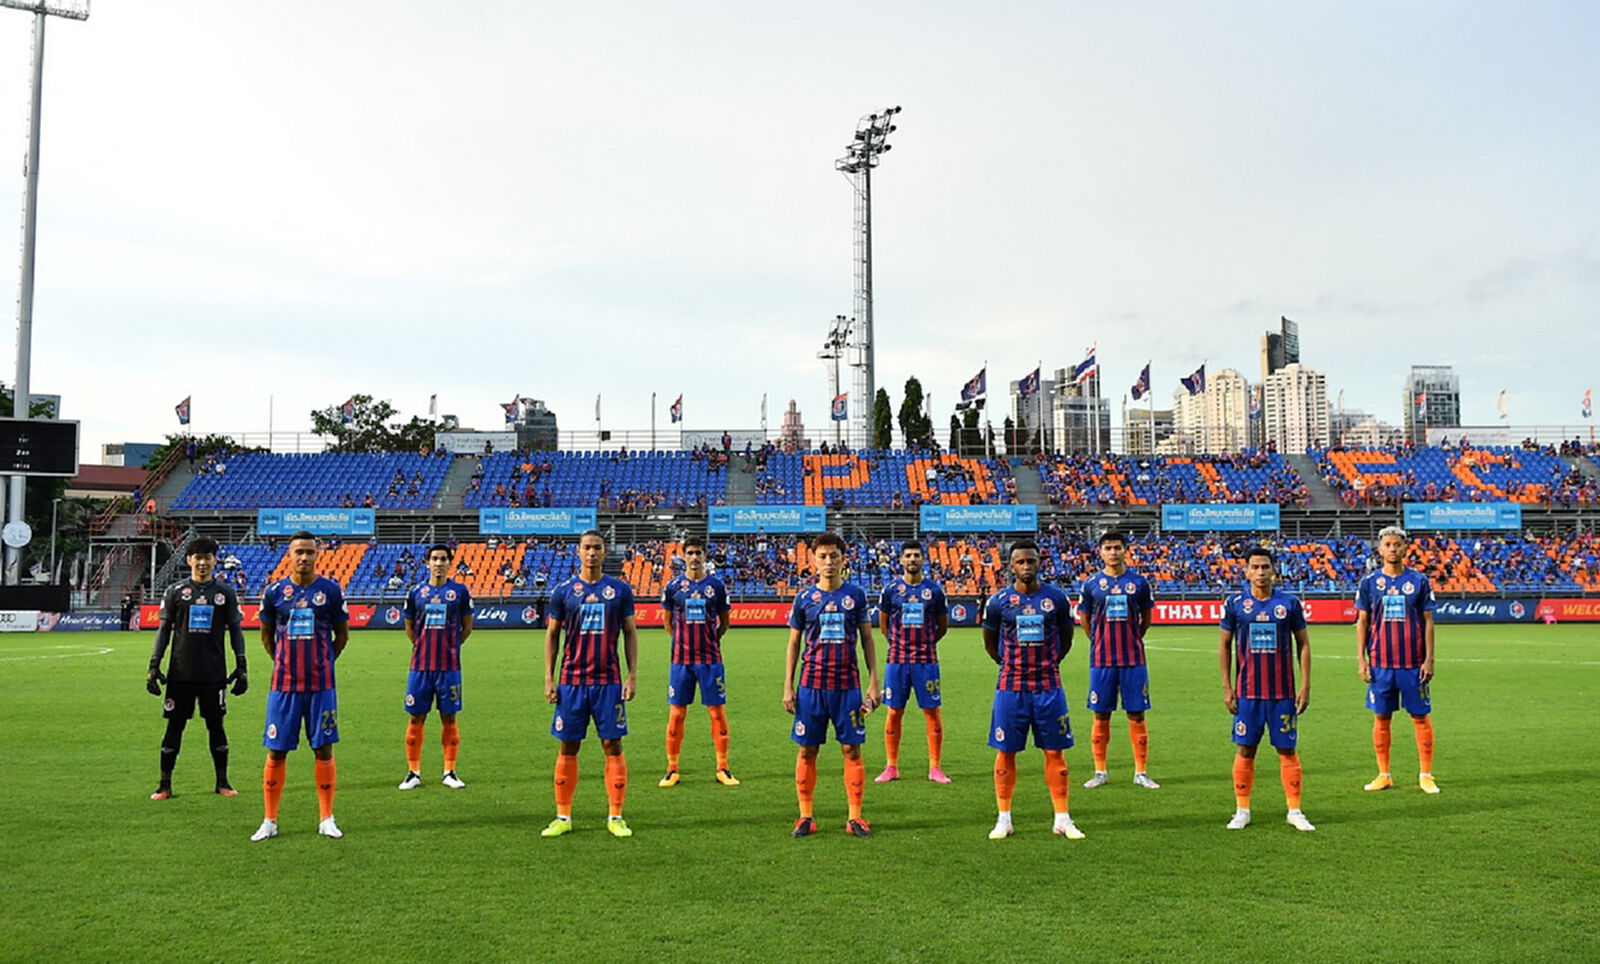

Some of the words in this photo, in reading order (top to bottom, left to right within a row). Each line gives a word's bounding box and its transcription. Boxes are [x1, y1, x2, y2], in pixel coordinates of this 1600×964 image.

[477, 607, 508, 622] Lion
[1156, 604, 1203, 620] THAI
[1465, 601, 1496, 616] Lion
[321, 709, 338, 729] 23
